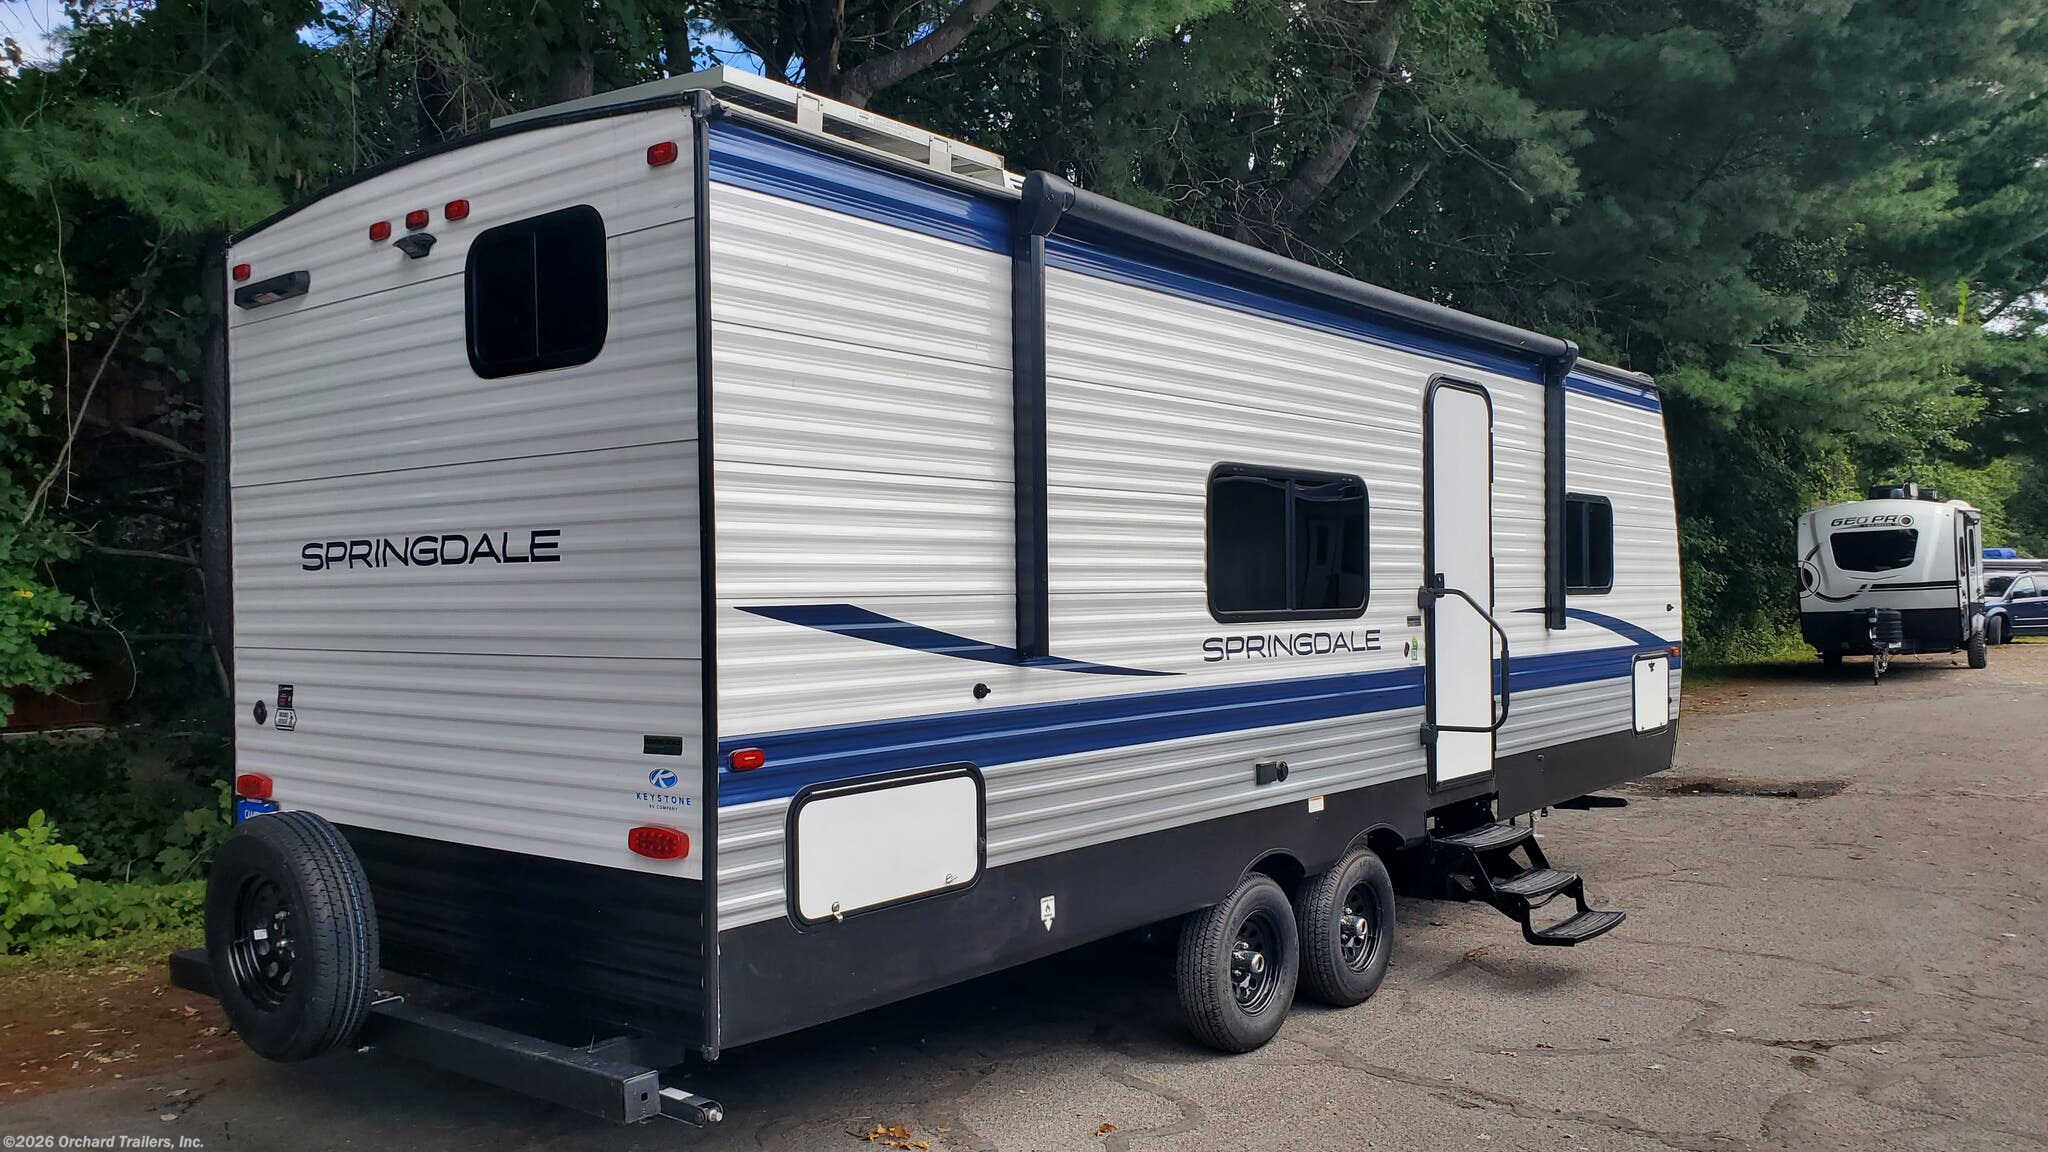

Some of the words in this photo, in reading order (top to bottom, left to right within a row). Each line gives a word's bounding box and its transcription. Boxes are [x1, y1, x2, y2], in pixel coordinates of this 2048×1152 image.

[1831, 516, 1870, 526] GEO
[302, 529, 561, 571] SPRINGDALE
[1202, 629, 1382, 662] SPRINGDALE
[636, 792, 692, 806] KEYSTONE
